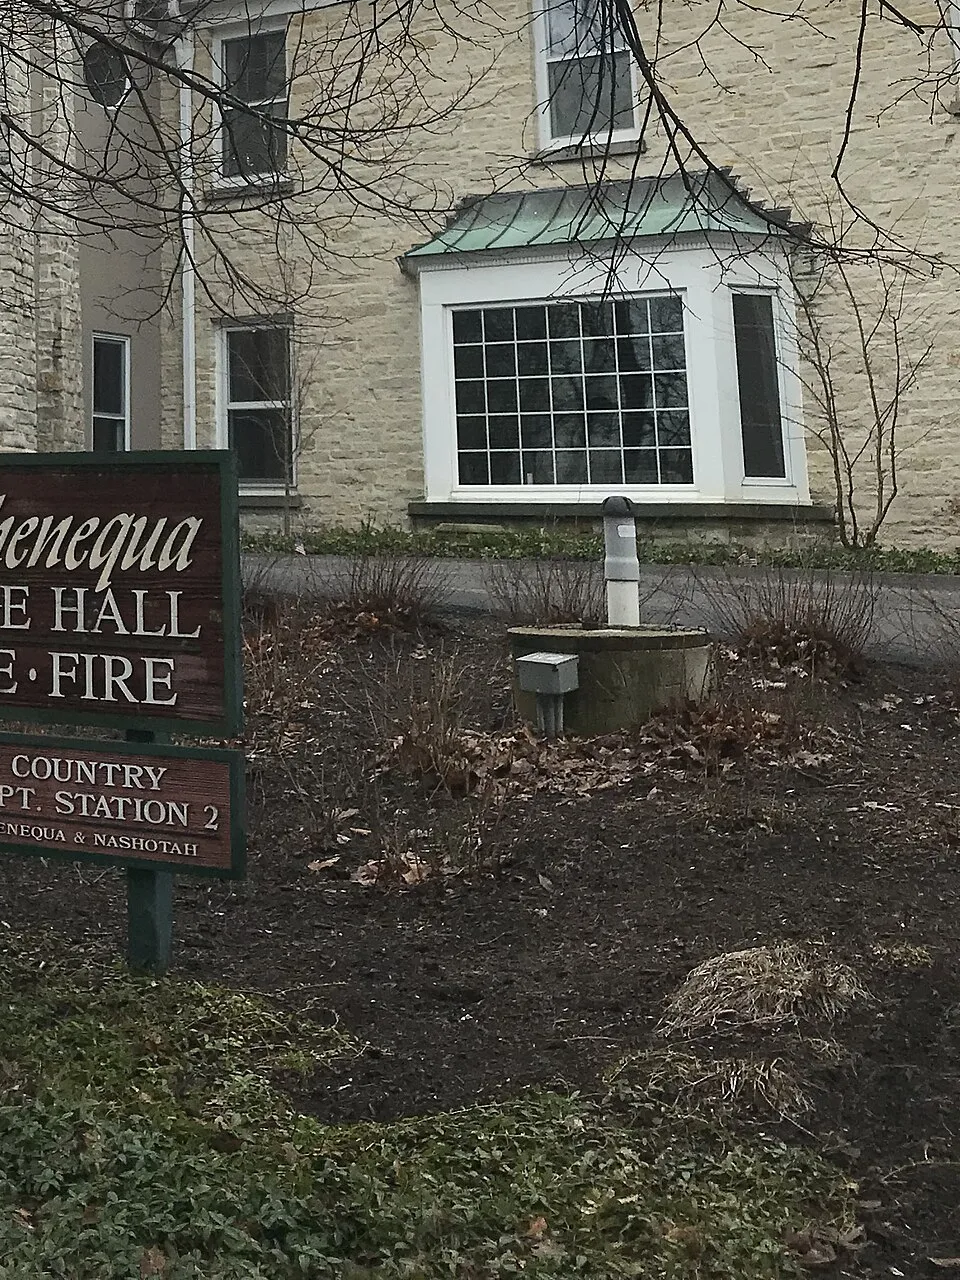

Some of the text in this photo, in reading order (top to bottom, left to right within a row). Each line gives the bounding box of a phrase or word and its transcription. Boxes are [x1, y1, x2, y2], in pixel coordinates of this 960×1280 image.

[50, 587, 201, 638] HALL
[48, 652, 178, 706] FIRE
[11, 755, 167, 791] COUNTRY
[55, 792, 189, 827] STATION
[203, 805, 219, 831] 2
[73, 832, 85, 844] &
[93, 834, 198, 856] NASHOTAH
